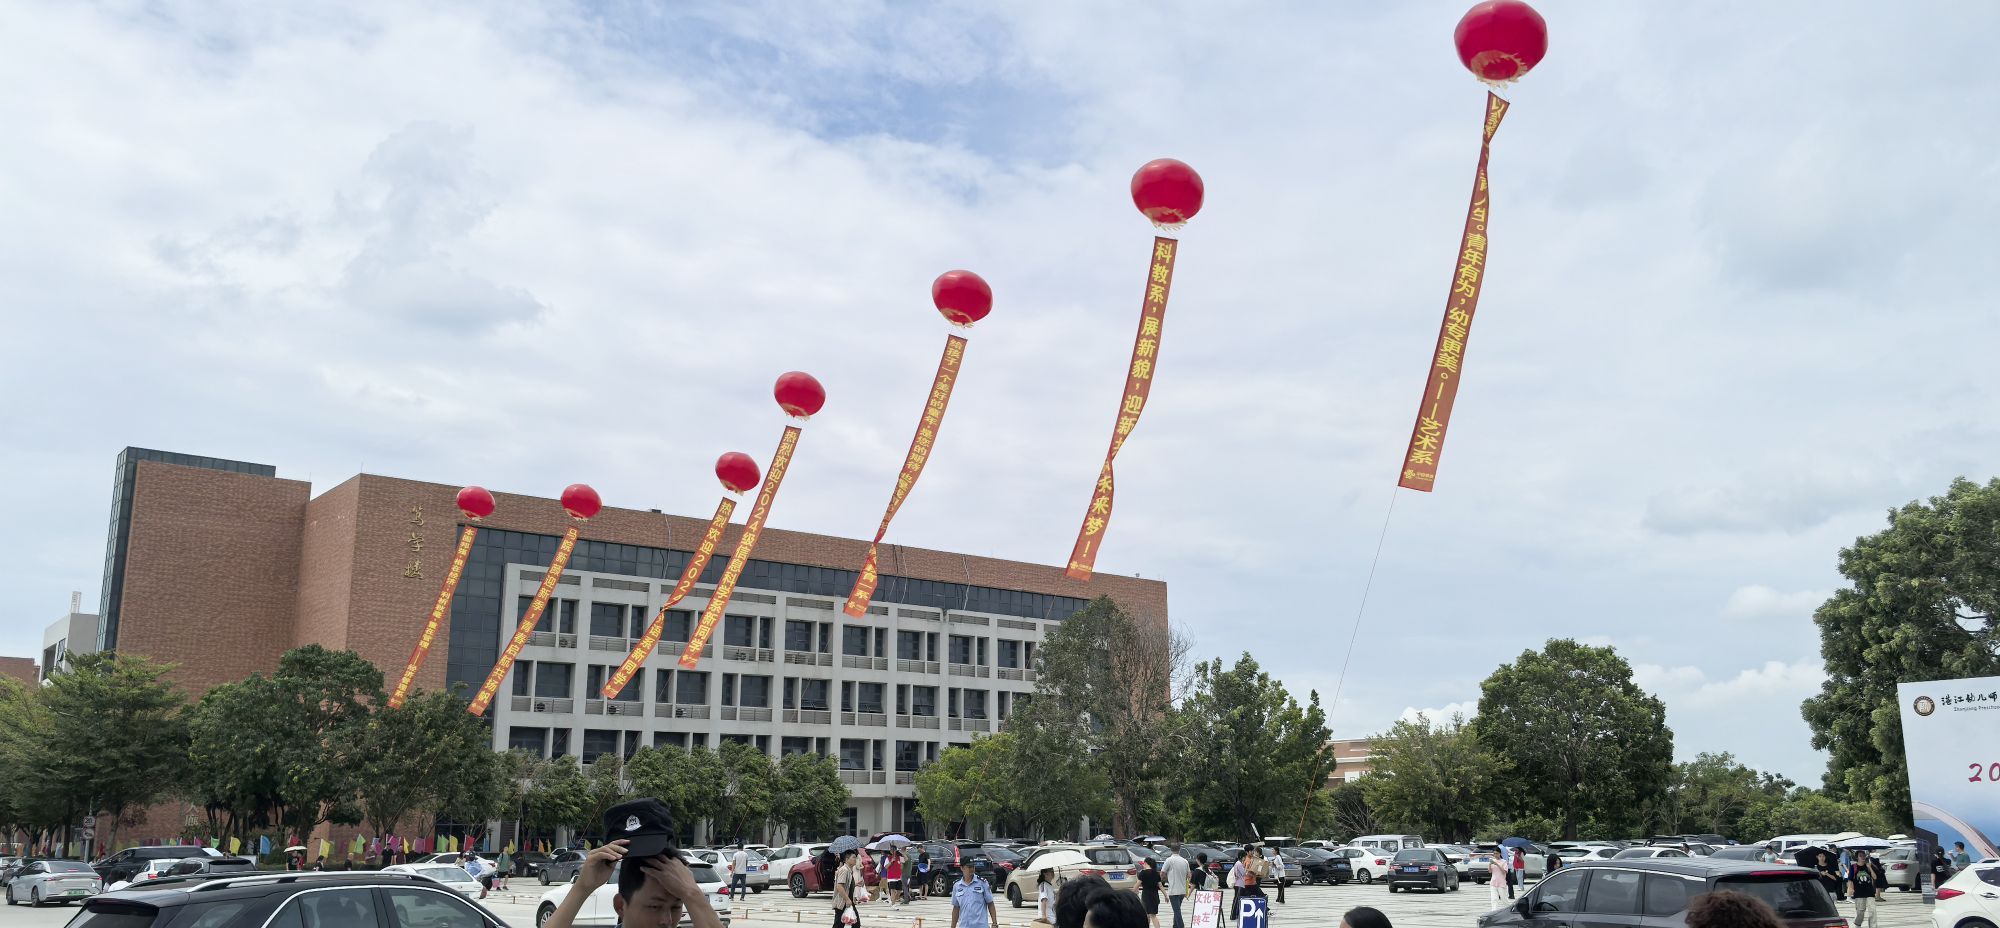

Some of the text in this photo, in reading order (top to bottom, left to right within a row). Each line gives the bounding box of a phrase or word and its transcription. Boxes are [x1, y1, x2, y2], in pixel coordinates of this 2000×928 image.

[612, 500, 733, 686] 热烈欢迎2024语系新同学
[688, 430, 798, 652] 热烈欢迎2024级信息科学系新同学
[1240, 899, 1256, 928] P
